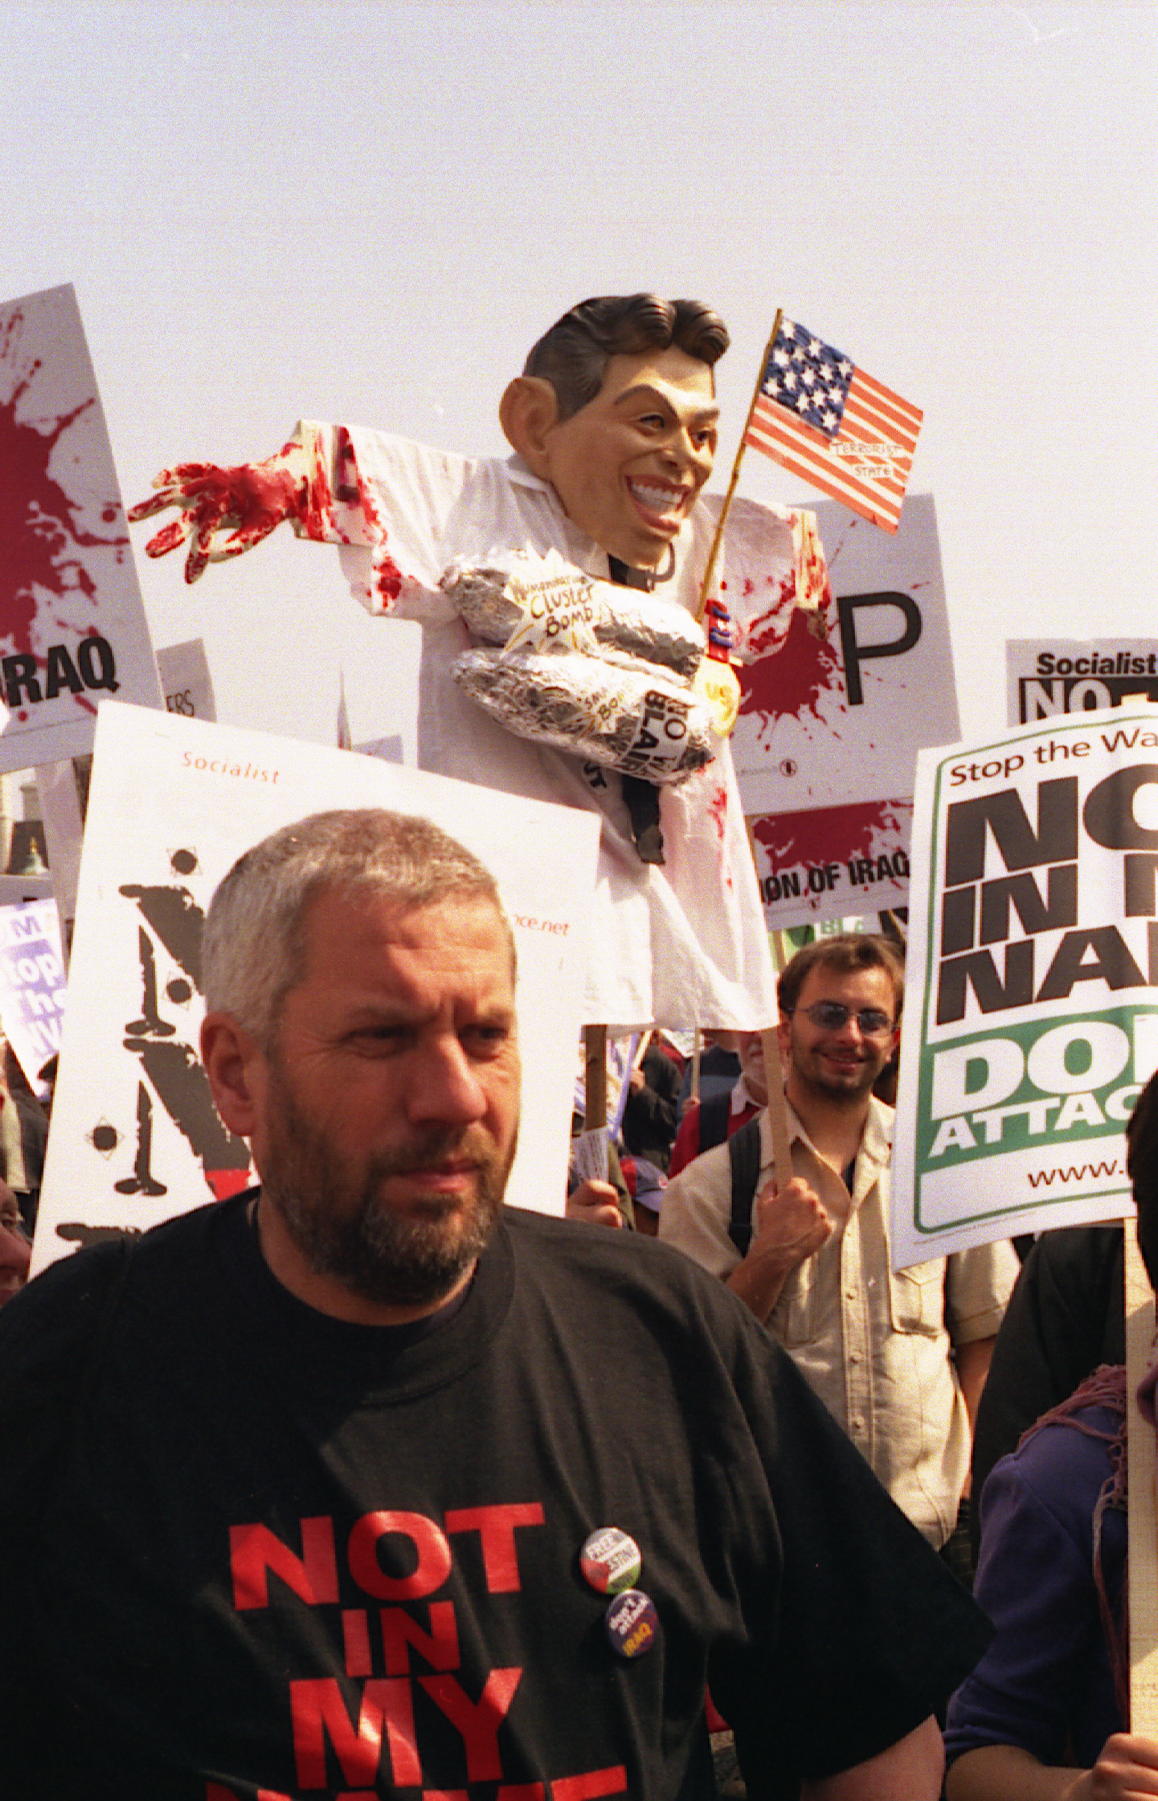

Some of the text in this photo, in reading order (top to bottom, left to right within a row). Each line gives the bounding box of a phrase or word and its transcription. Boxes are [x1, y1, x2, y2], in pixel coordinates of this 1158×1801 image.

[0, 636, 121, 708] RAQ
[1036, 652, 1158, 676] Socialist
[183, 751, 280, 784] Socialist
[949, 754, 1025, 788] Stop
[1033, 740, 1092, 765] the
[808, 864, 841, 893] OF
[941, 863, 1079, 958] IN
[228, 1502, 546, 1611] NOT
[341, 1601, 461, 1678] IN
[289, 1666, 523, 1790] MY
